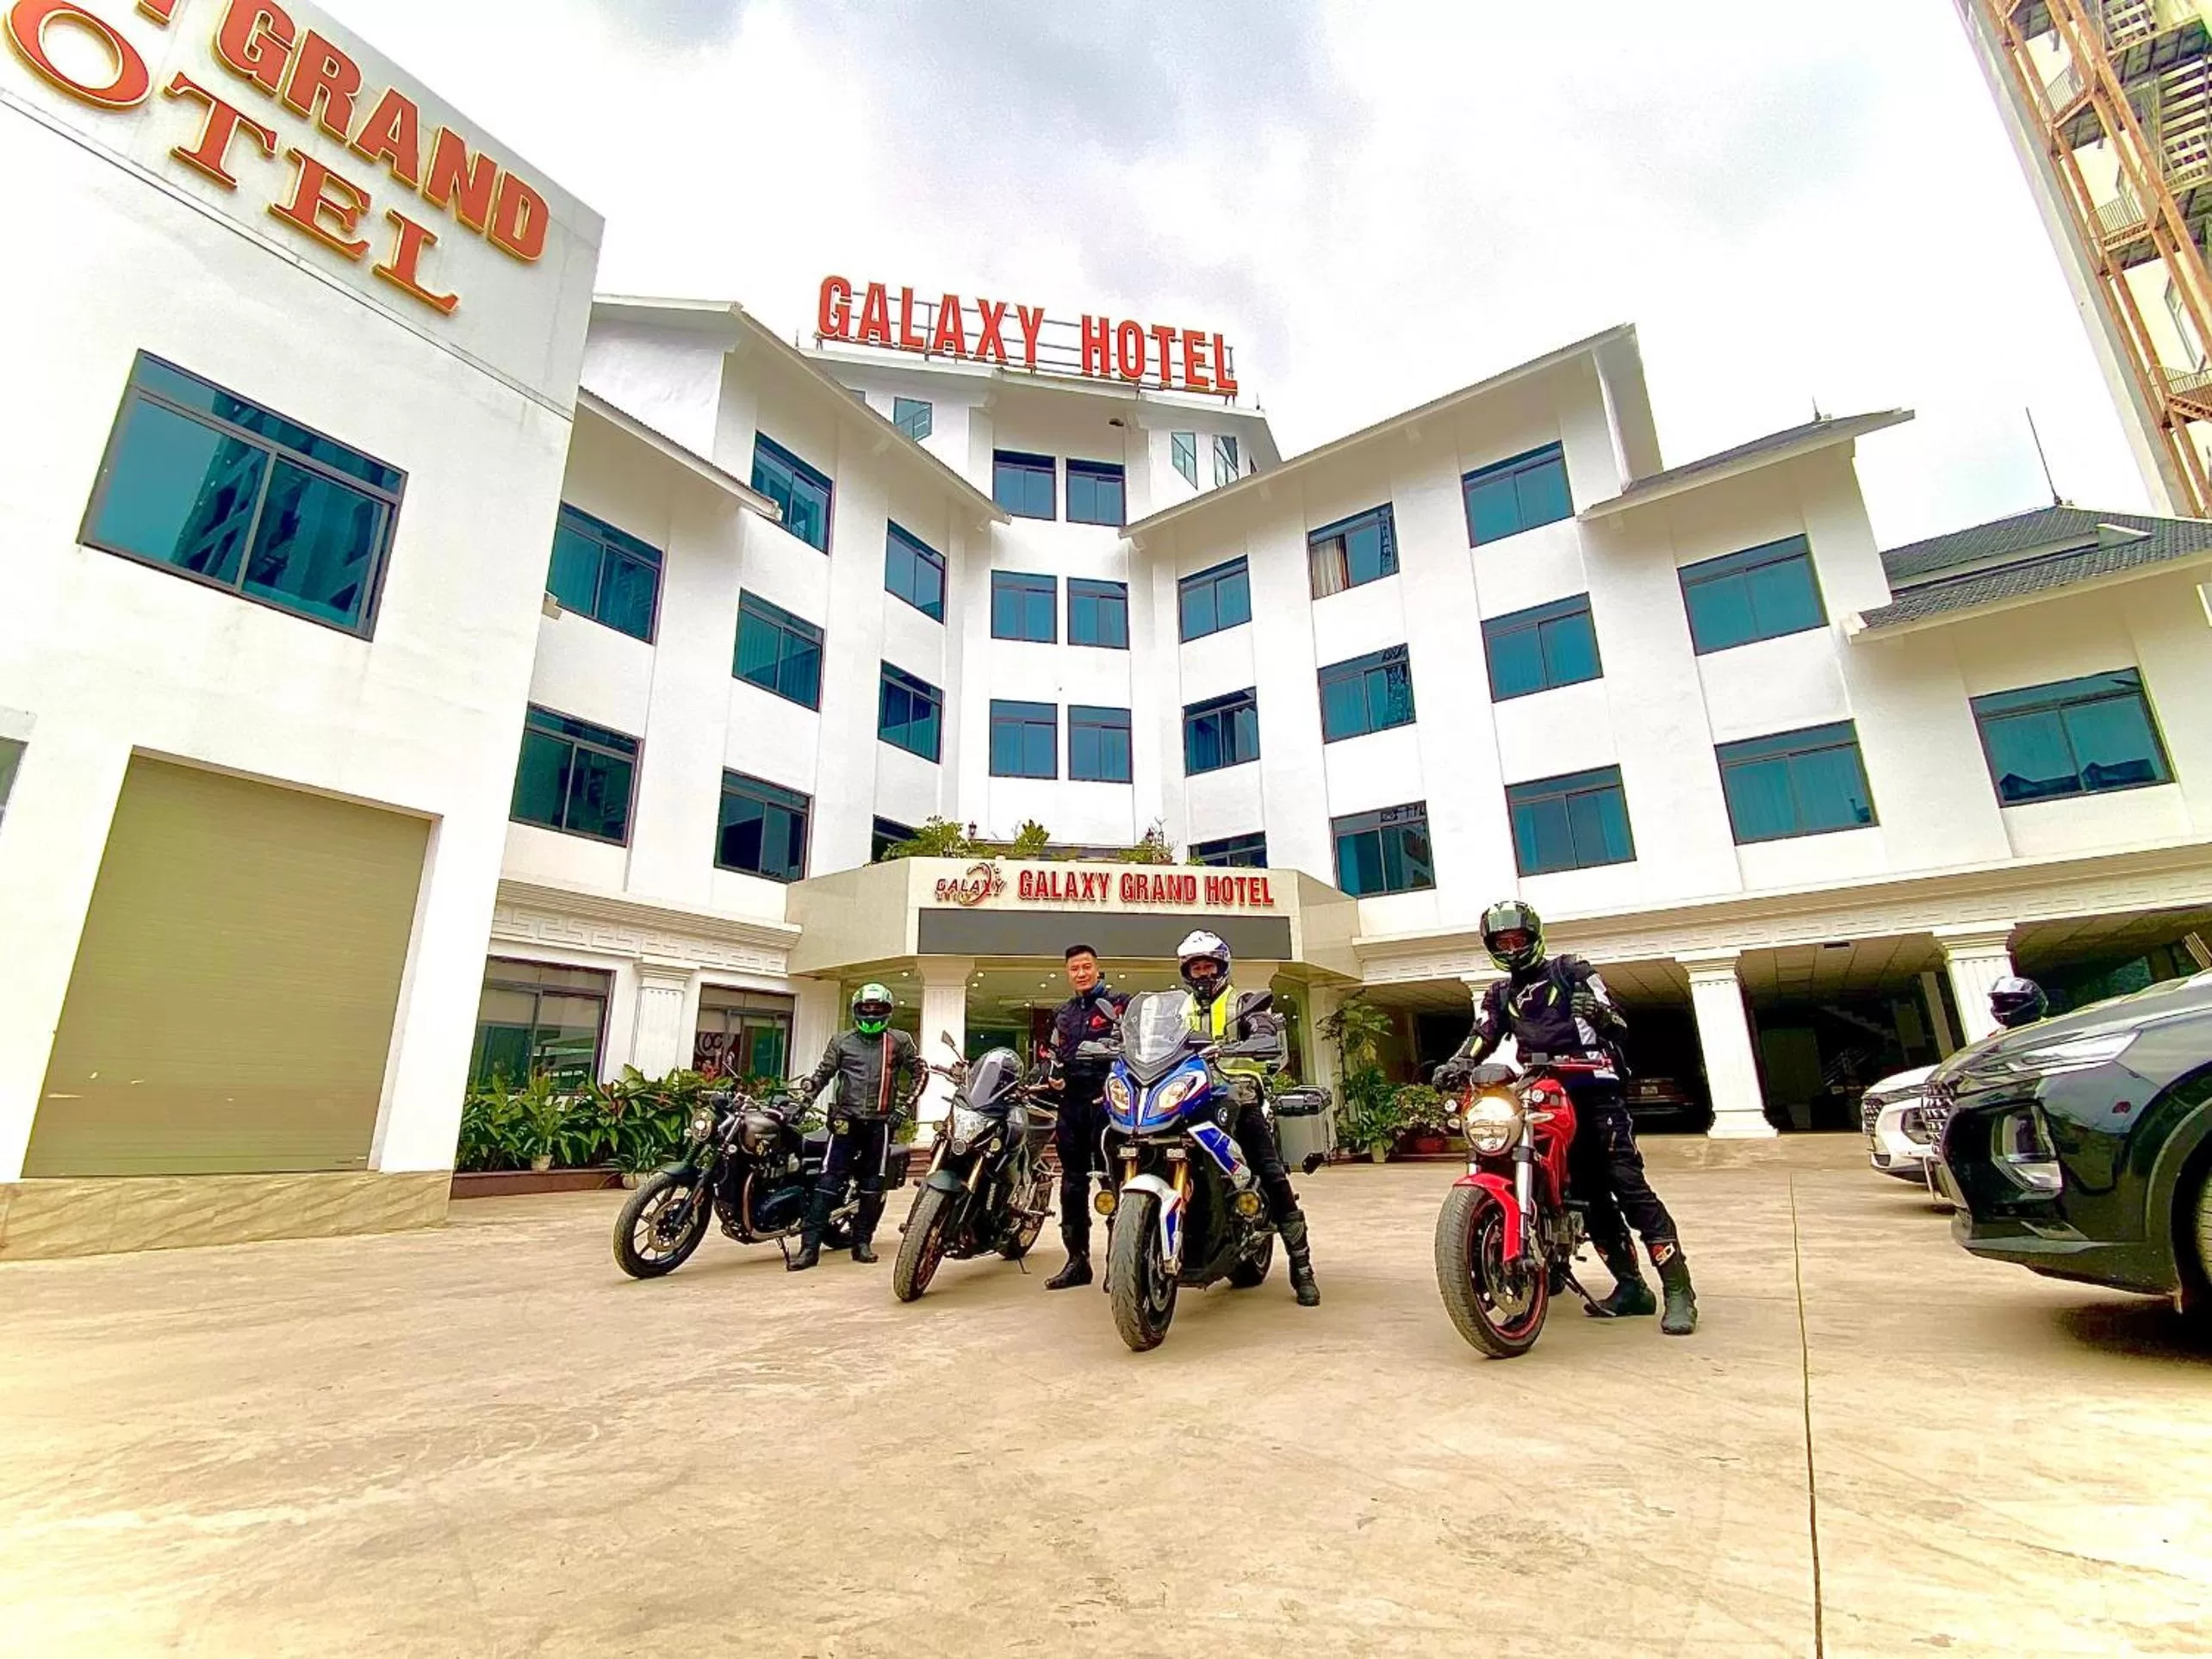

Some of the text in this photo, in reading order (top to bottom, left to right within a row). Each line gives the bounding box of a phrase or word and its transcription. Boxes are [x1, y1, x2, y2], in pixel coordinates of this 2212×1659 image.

[213, 0, 550, 264] GRAND
[817, 274, 1239, 395] GALAXY HOTEL
[935, 878, 1006, 897] GALAXY
[1018, 869, 1275, 907] GALAXY GRAND HOTEL
